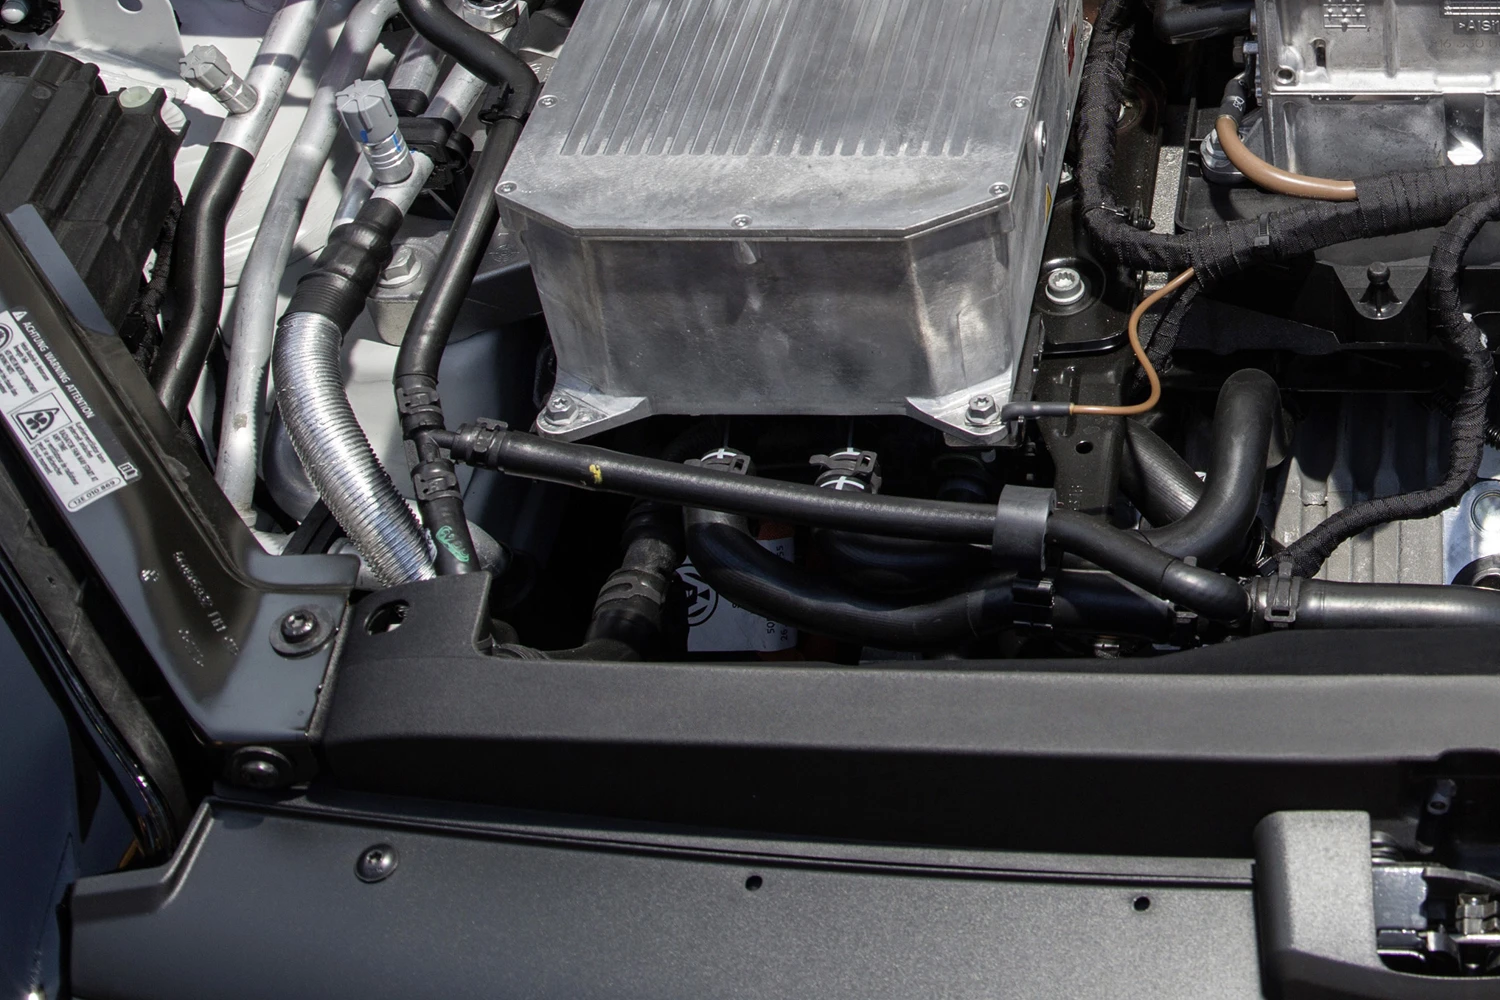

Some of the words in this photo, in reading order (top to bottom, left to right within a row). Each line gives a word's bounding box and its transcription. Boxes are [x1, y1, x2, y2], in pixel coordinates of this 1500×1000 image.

[22, 321, 49, 352] ACHTUNG
[44, 352, 71, 384] WARNING
[65, 384, 95, 419] ATTENTION
